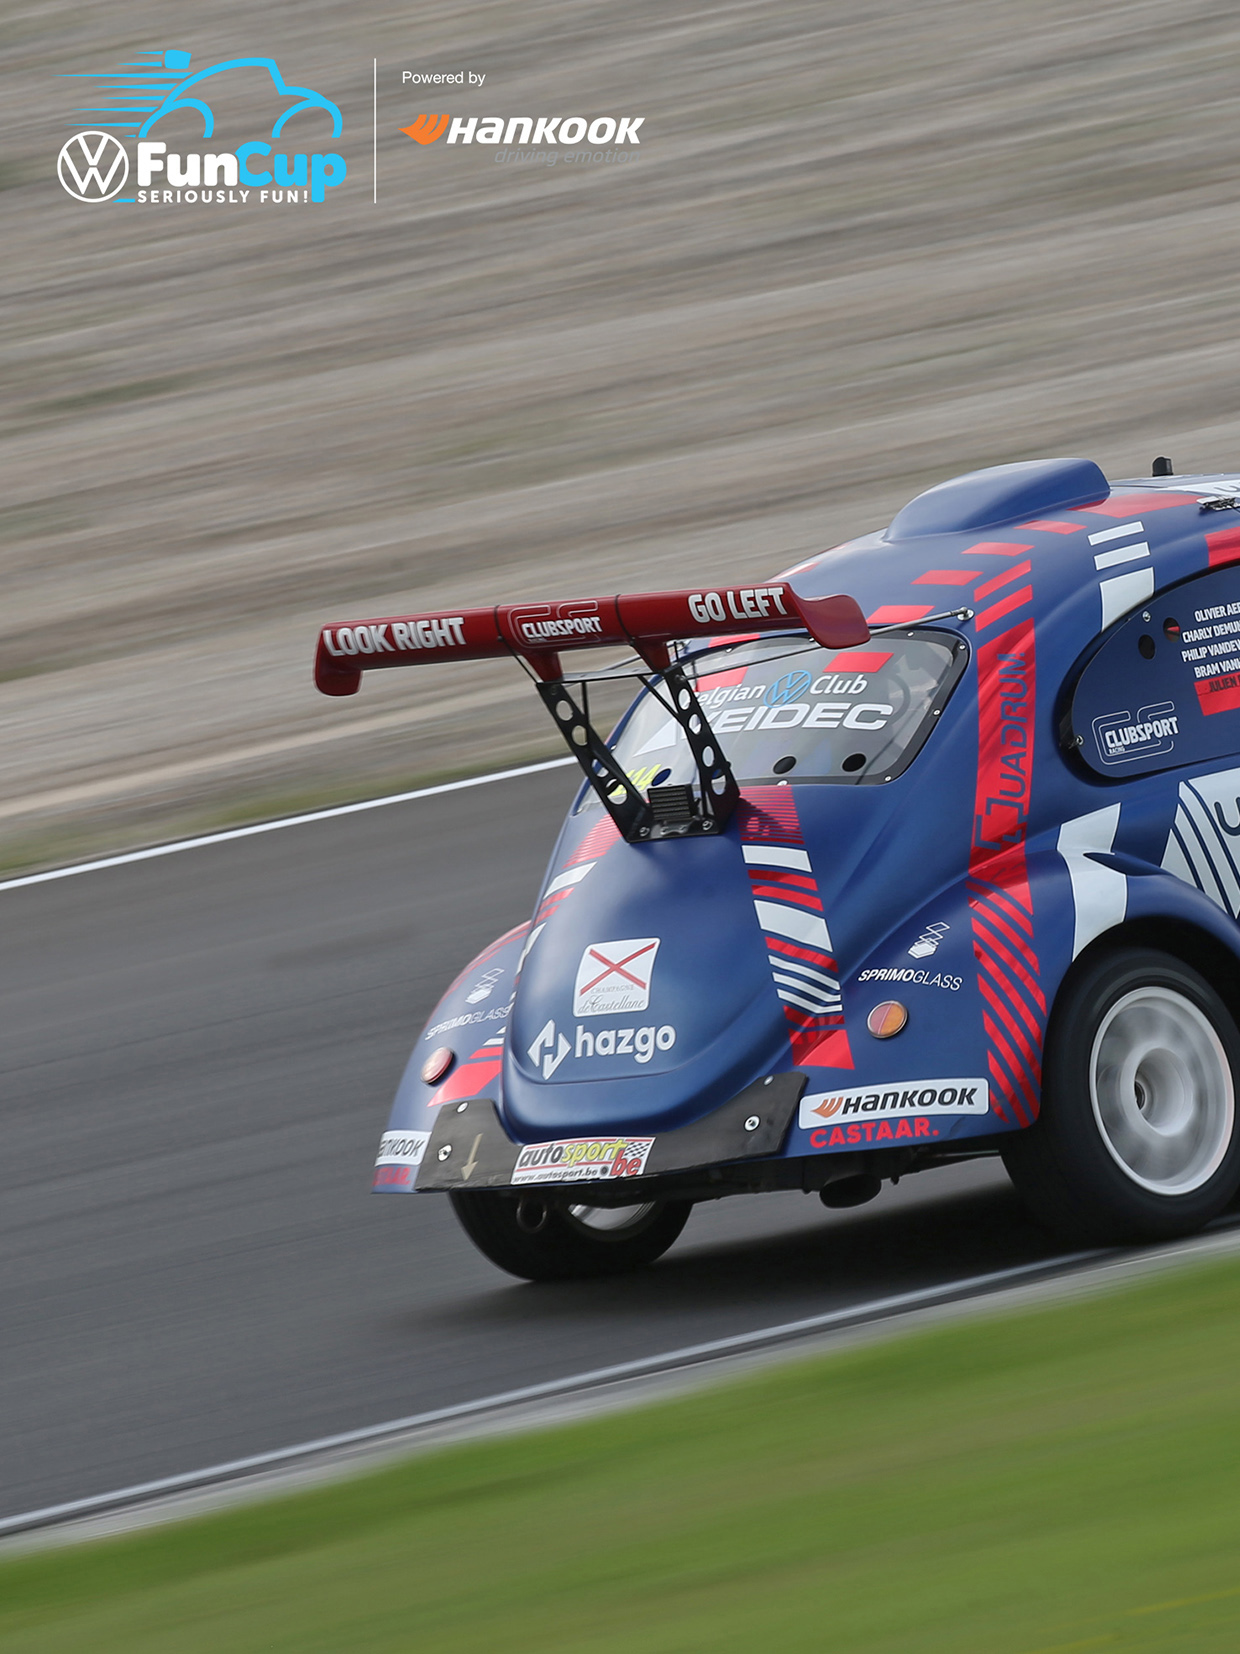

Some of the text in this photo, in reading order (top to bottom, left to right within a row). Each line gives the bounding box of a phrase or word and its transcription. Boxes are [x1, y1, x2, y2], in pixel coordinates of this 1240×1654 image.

[688, 587, 787, 623] GO LEFT
[1194, 605, 1227, 622] OLIVIER
[323, 617, 466, 657] LOOK RIGHT
[521, 617, 602, 638] CLUBSPORT
[1182, 626, 1212, 643] CHARLY
[1181, 647, 1208, 662] PHILIP
[1194, 662, 1220, 678] BRAM
[685, 683, 766, 708] elgian
[809, 674, 868, 695] Club
[1208, 676, 1237, 692] JULIEN
[1105, 716, 1178, 748] CLUBSPORT
[858, 968, 963, 991] SPRIMOGLASS
[575, 1025, 676, 1063] hazgo
